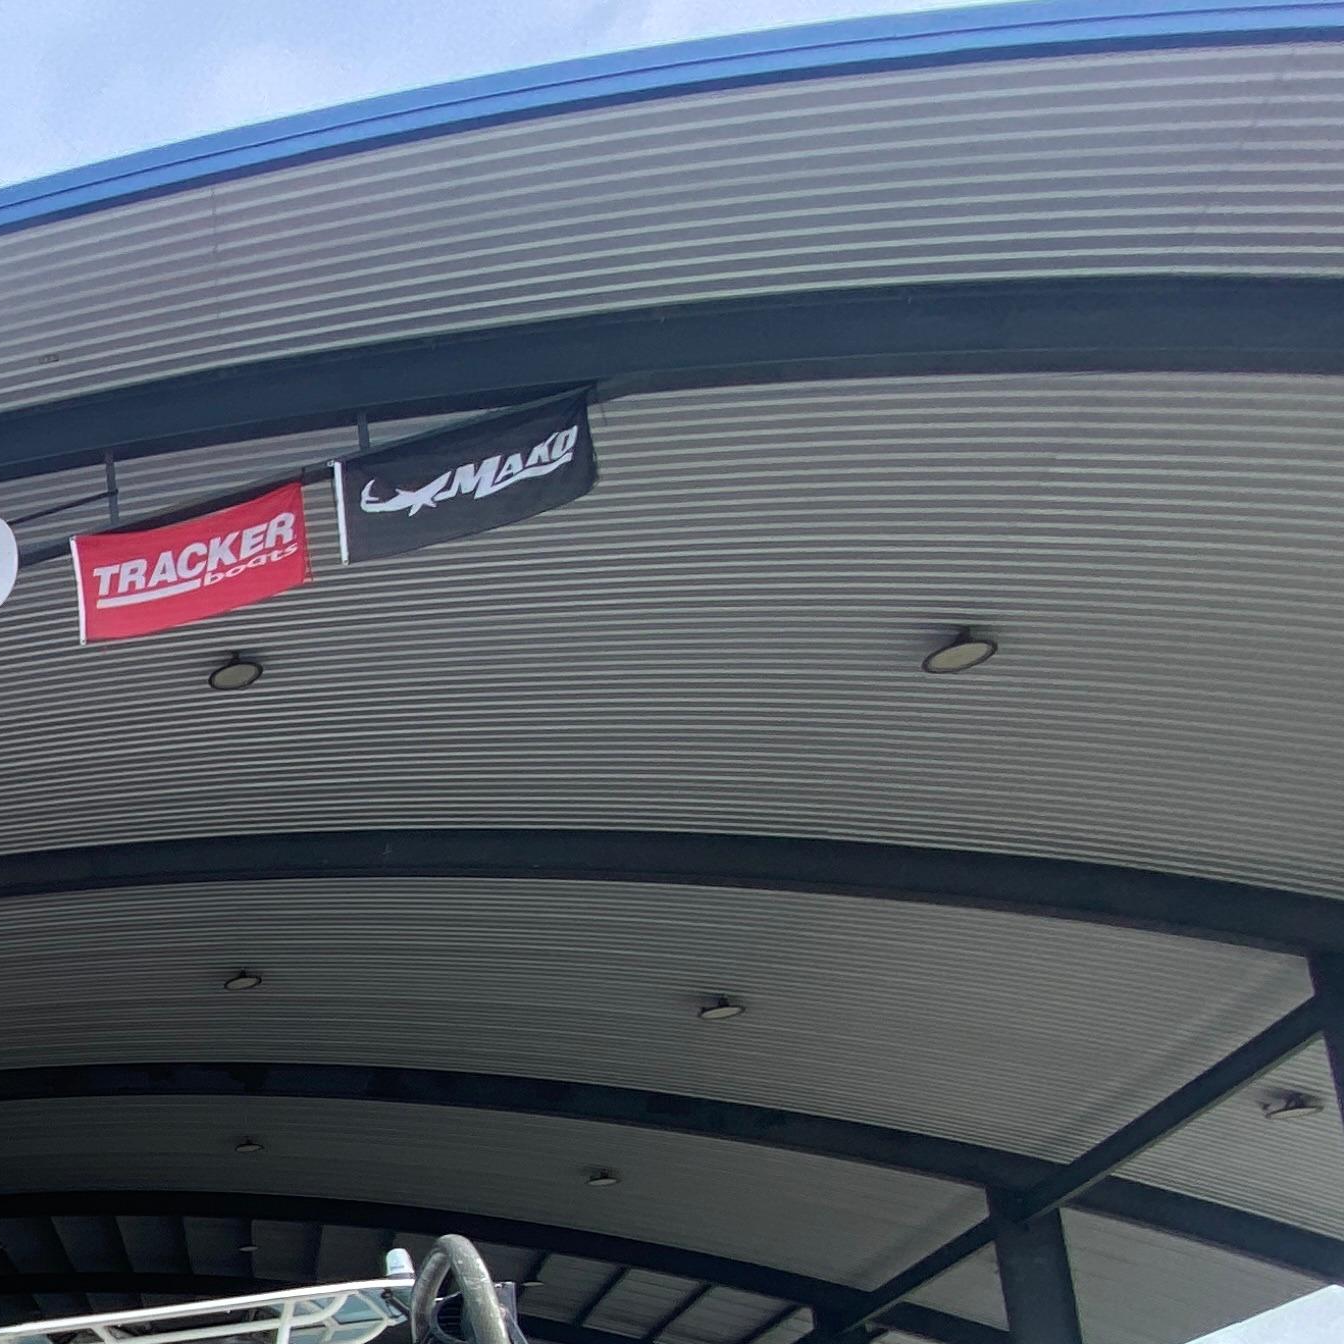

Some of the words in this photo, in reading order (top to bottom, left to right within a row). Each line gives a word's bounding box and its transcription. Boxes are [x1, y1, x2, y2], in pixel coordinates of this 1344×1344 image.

[436, 424, 579, 500] MAKO
[93, 512, 296, 597] TRACKER
[203, 541, 299, 587] boats
